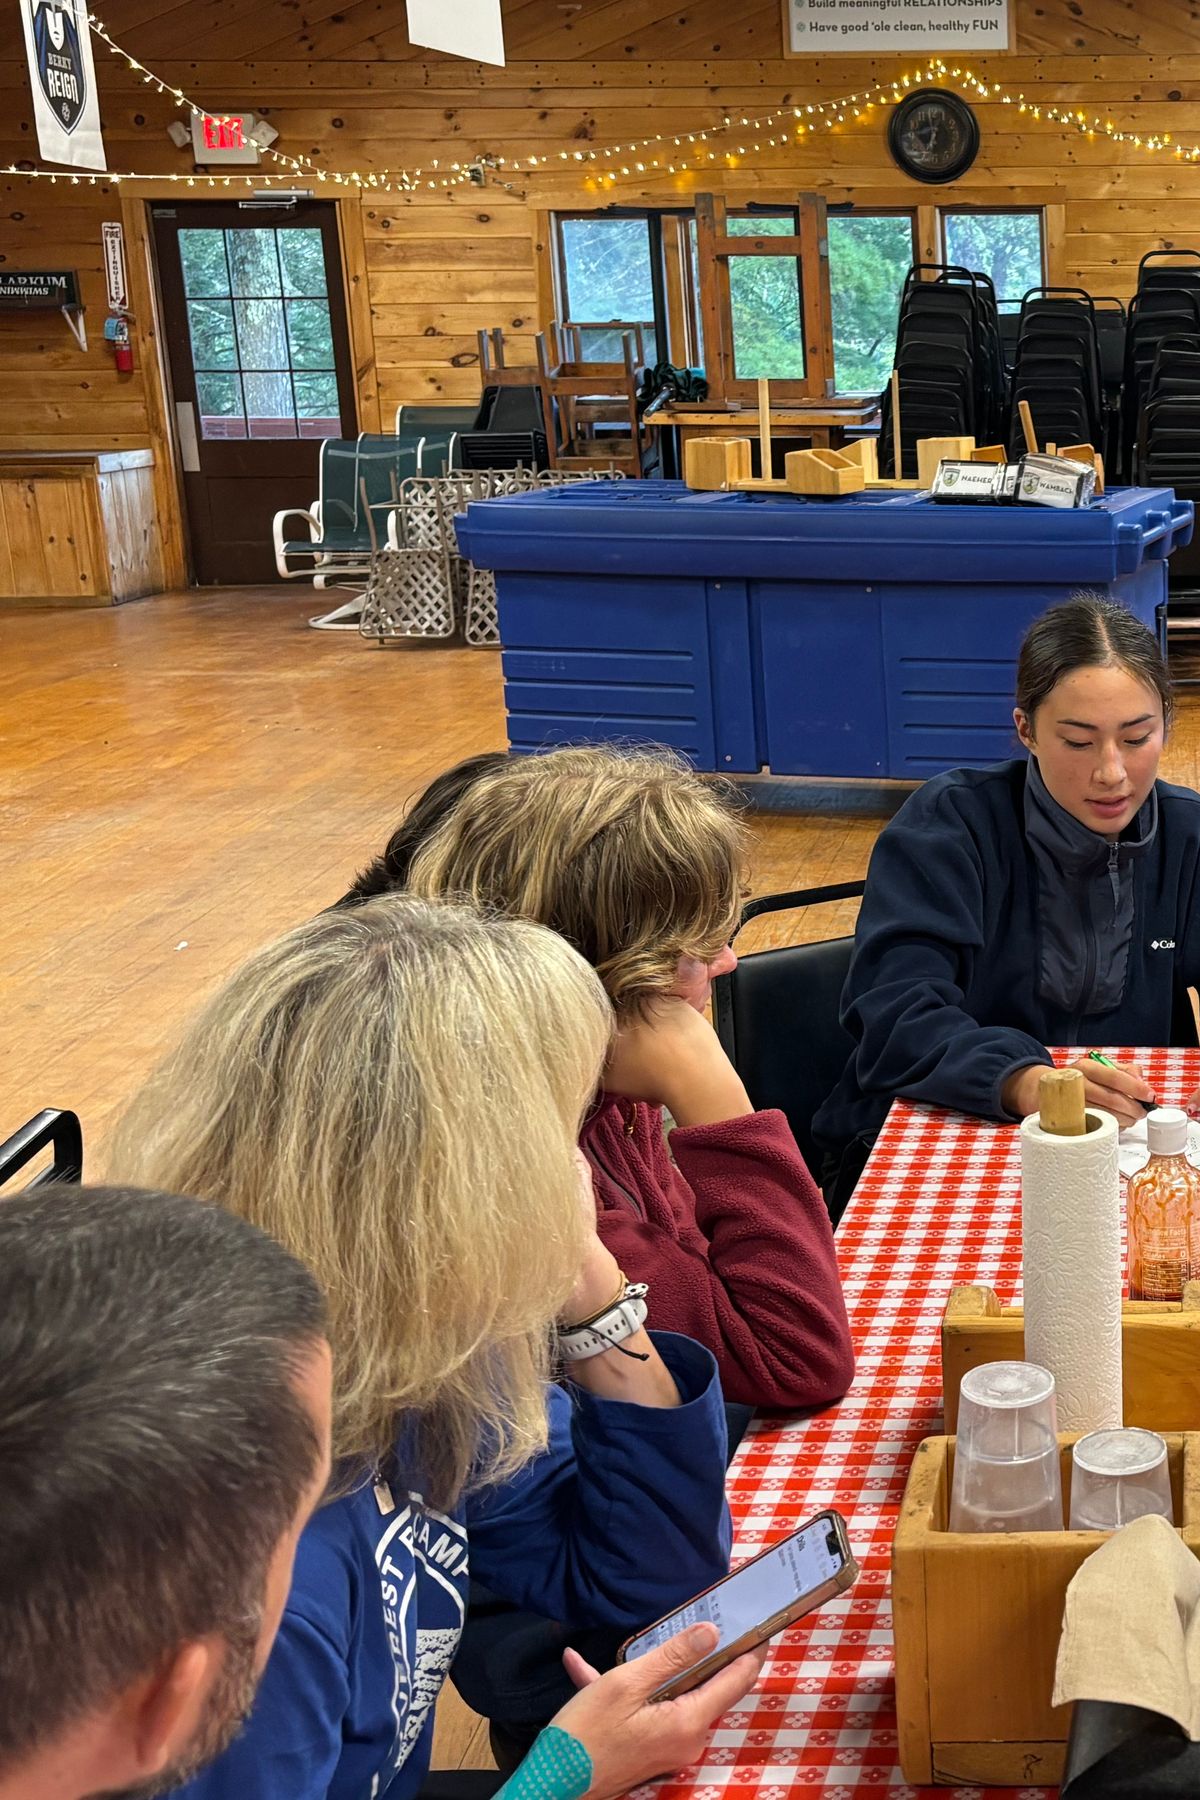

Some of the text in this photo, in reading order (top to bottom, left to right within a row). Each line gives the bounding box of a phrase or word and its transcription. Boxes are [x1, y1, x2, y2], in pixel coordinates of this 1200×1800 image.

[808, 0, 836, 8] Build
[839, 0, 901, 10] meaningful
[809, 21, 838, 32] Have
[841, 21, 869, 34] good
[894, 20, 926, 32] clean,
[928, 20, 970, 33] healthy
[972, 19, 999, 30] FUN
[105, 230, 120, 238] FIRE
